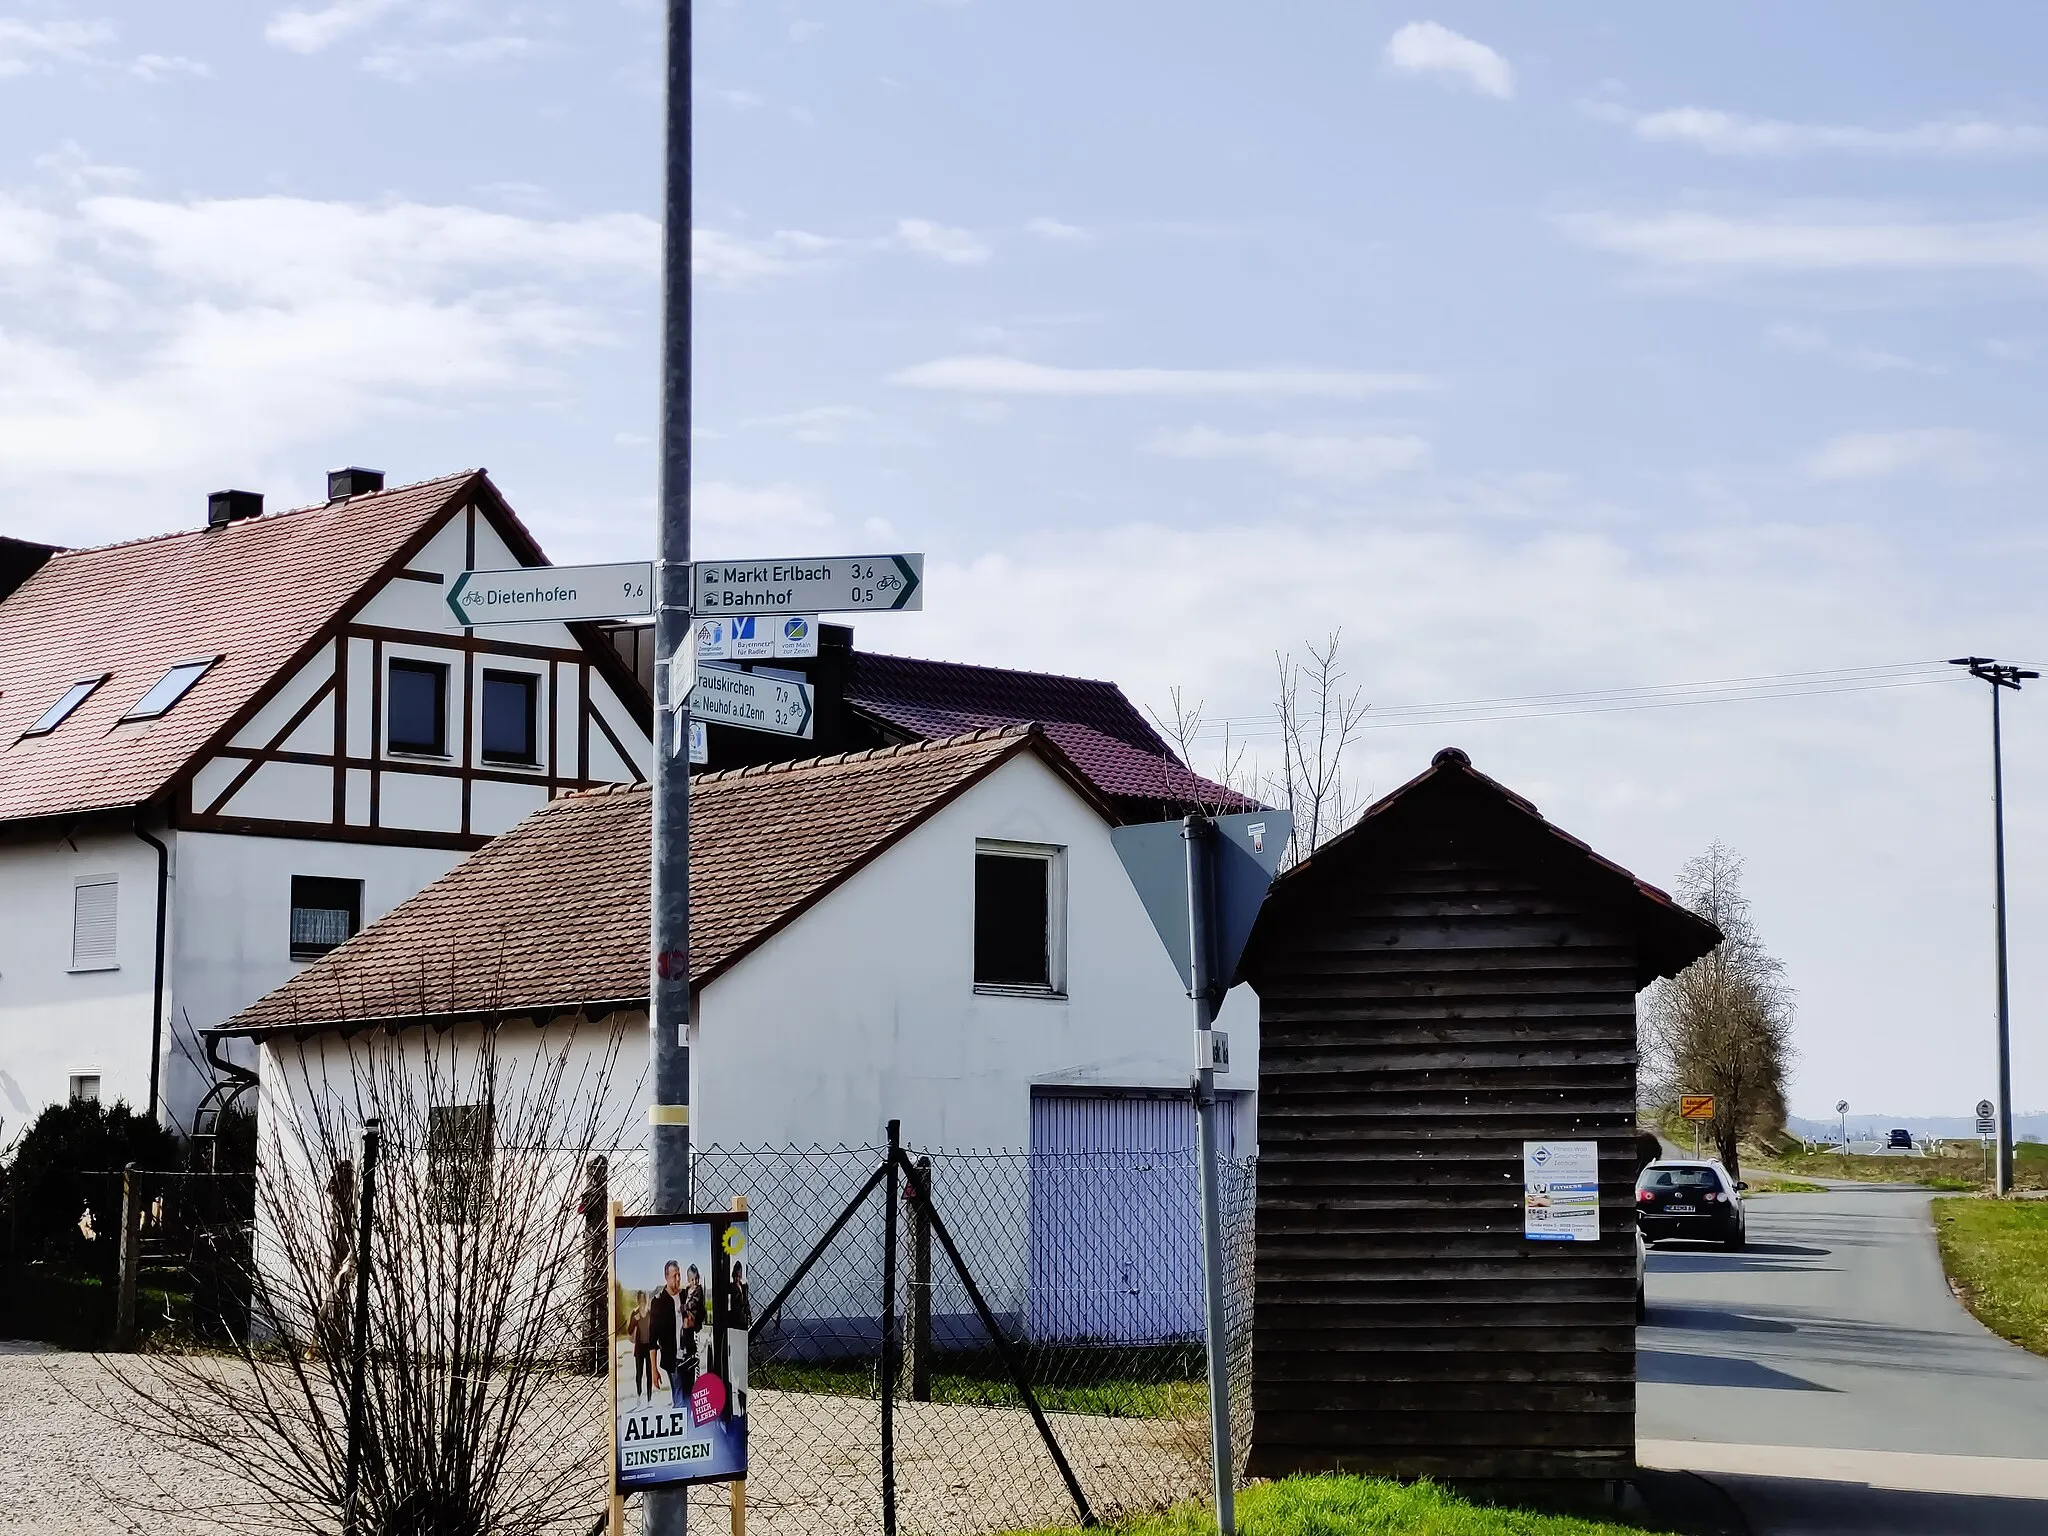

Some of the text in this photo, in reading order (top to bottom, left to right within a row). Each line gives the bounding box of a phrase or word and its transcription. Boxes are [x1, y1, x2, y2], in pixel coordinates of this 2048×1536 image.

[723, 564, 874, 583] Markt Erlbach 3,6
[487, 582, 644, 605] Dietenhofen 9,6
[722, 587, 874, 606] Bahnhof 0,5
[737, 648, 747, 656] für
[698, 676, 789, 703] rautskirchen 7,9
[703, 696, 732, 715] Neuhof
[775, 709, 788, 725] 3,2
[692, 1388, 710, 1400] WEIL
[694, 1396, 708, 1407] WIR
[695, 1403, 711, 1415] HIER
[697, 1408, 717, 1422] LEBEN
[624, 1412, 683, 1442] ALLE
[624, 1443, 711, 1467] EINSTEIGEN
